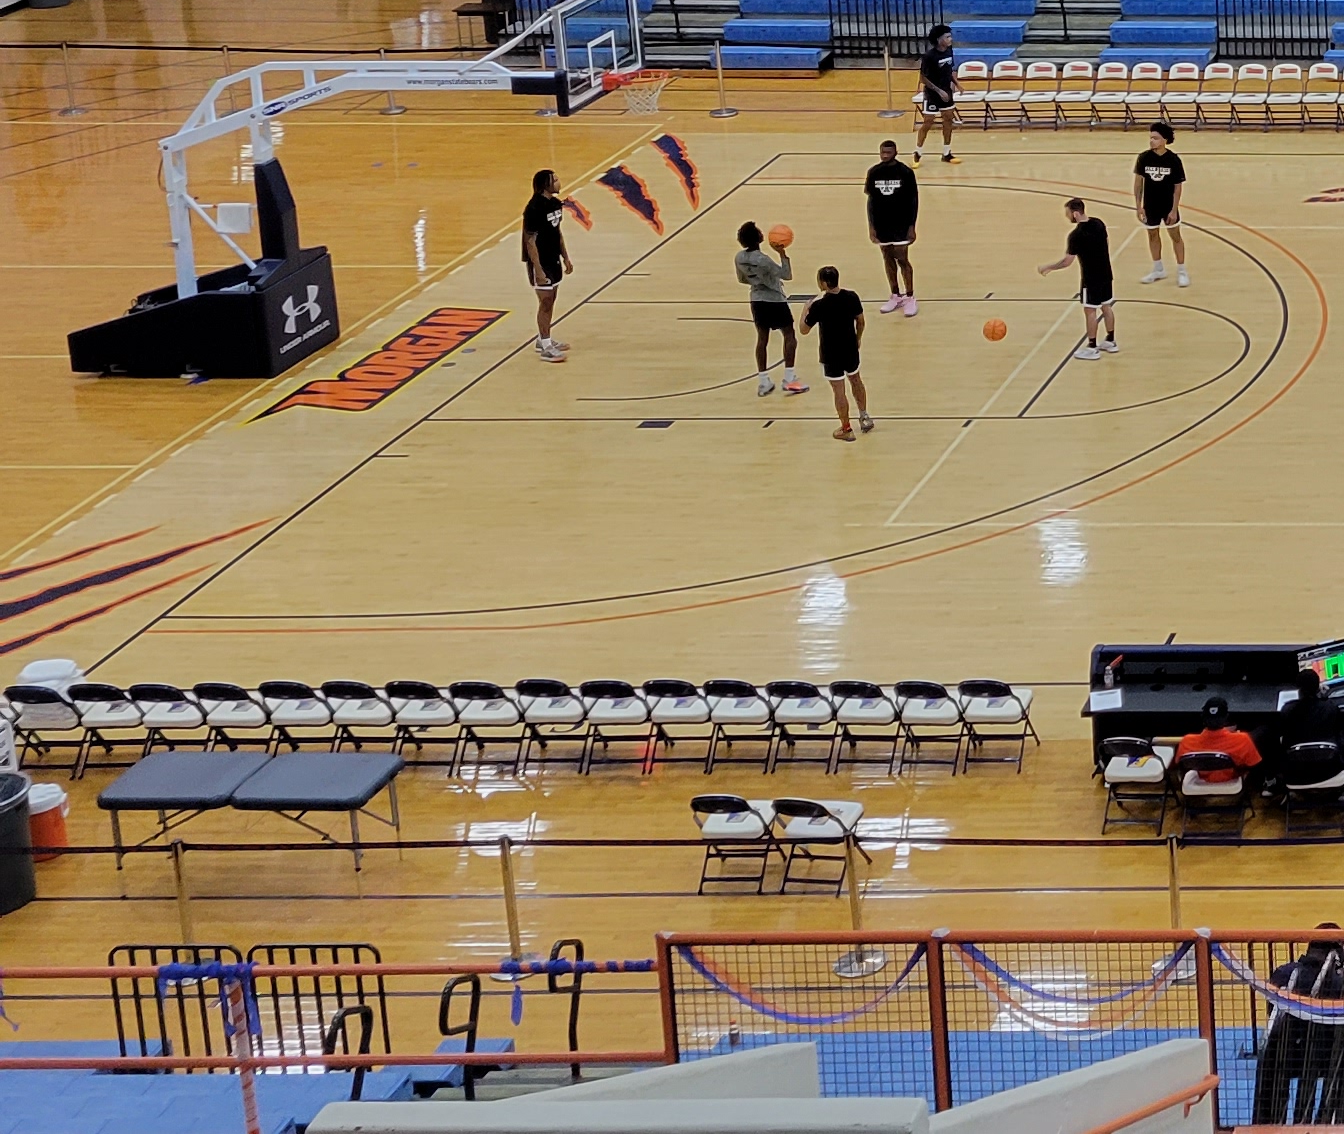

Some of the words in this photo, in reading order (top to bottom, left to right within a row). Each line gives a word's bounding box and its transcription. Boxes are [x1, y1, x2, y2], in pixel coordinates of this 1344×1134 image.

[287, 86, 332, 106] SPORTS
[279, 335, 302, 355] UNDER
[302, 319, 331, 341] ARMOUR
[265, 307, 505, 412] MORGAN
